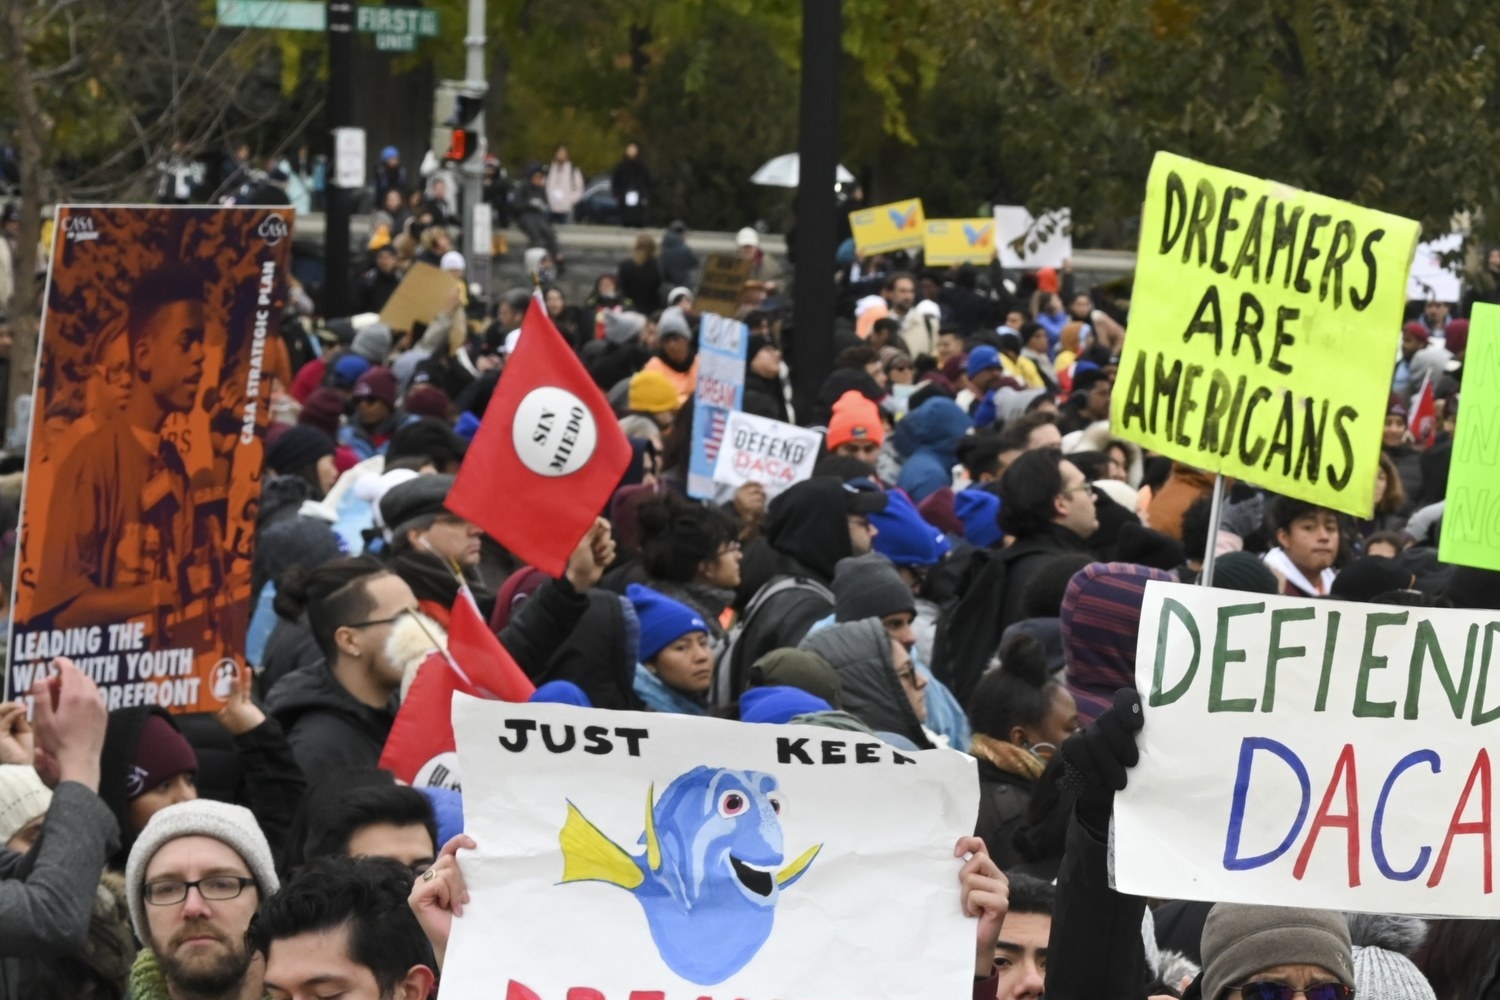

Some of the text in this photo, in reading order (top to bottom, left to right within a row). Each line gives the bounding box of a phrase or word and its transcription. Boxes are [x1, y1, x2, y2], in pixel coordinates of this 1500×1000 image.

[358, 7, 420, 33] FIRST
[1158, 170, 1386, 312] DREAMERS
[1183, 284, 1300, 375] ARE
[240, 261, 276, 445] CASA STRATEGIC PLAN
[532, 406, 556, 447] SIN
[549, 405, 585, 473] MIEDO
[1122, 349, 1360, 492] AMERICANS
[734, 429, 805, 465] DEFEND
[735, 449, 795, 482] DACA
[14, 621, 146, 662] LEADING THE
[125, 648, 194, 681] YOUTH
[100, 677, 201, 713] OREFRONT
[499, 718, 649, 757] JUST
[1222, 736, 1493, 894] DACA
